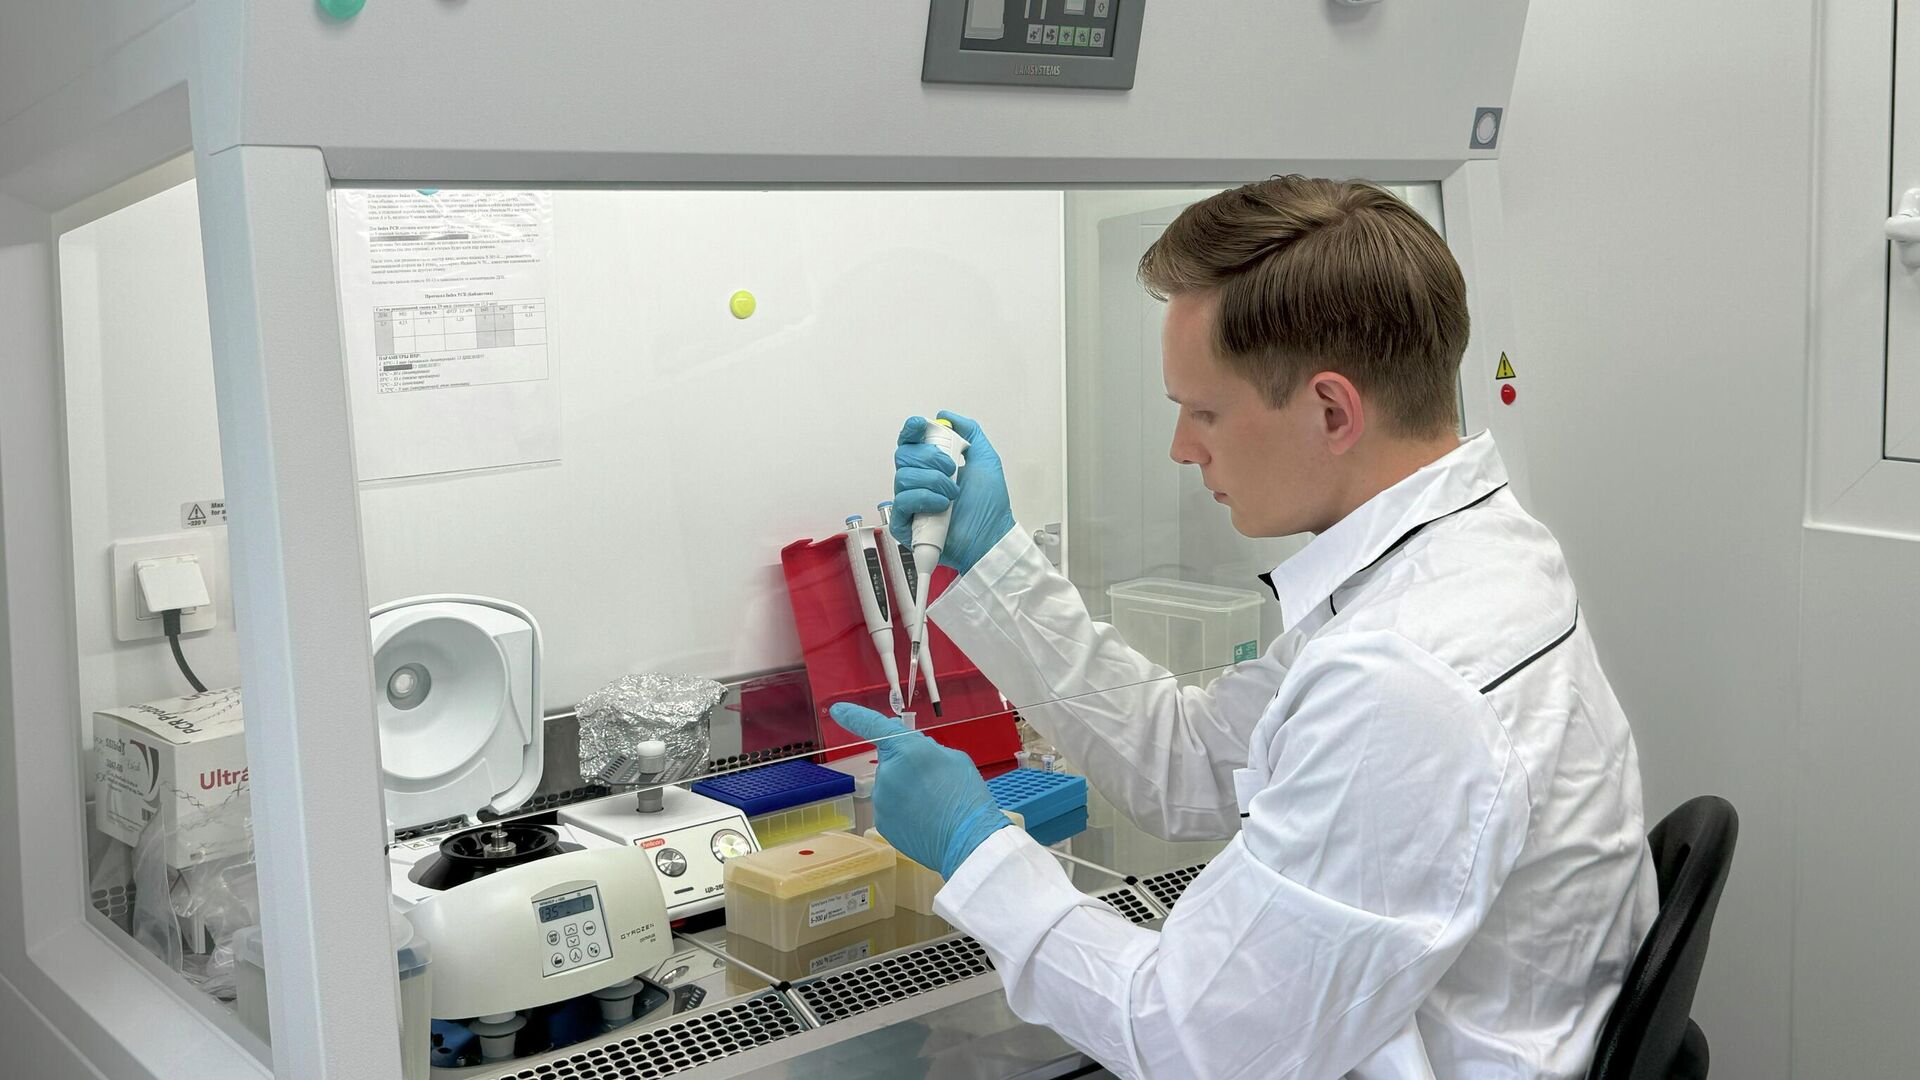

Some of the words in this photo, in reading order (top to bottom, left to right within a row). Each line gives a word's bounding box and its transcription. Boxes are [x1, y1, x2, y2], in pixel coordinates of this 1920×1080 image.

[1014, 64, 1061, 76] LAMSYSTEMS
[168, 718, 203, 734] PCR
[620, 923, 655, 939] GYROZEN
